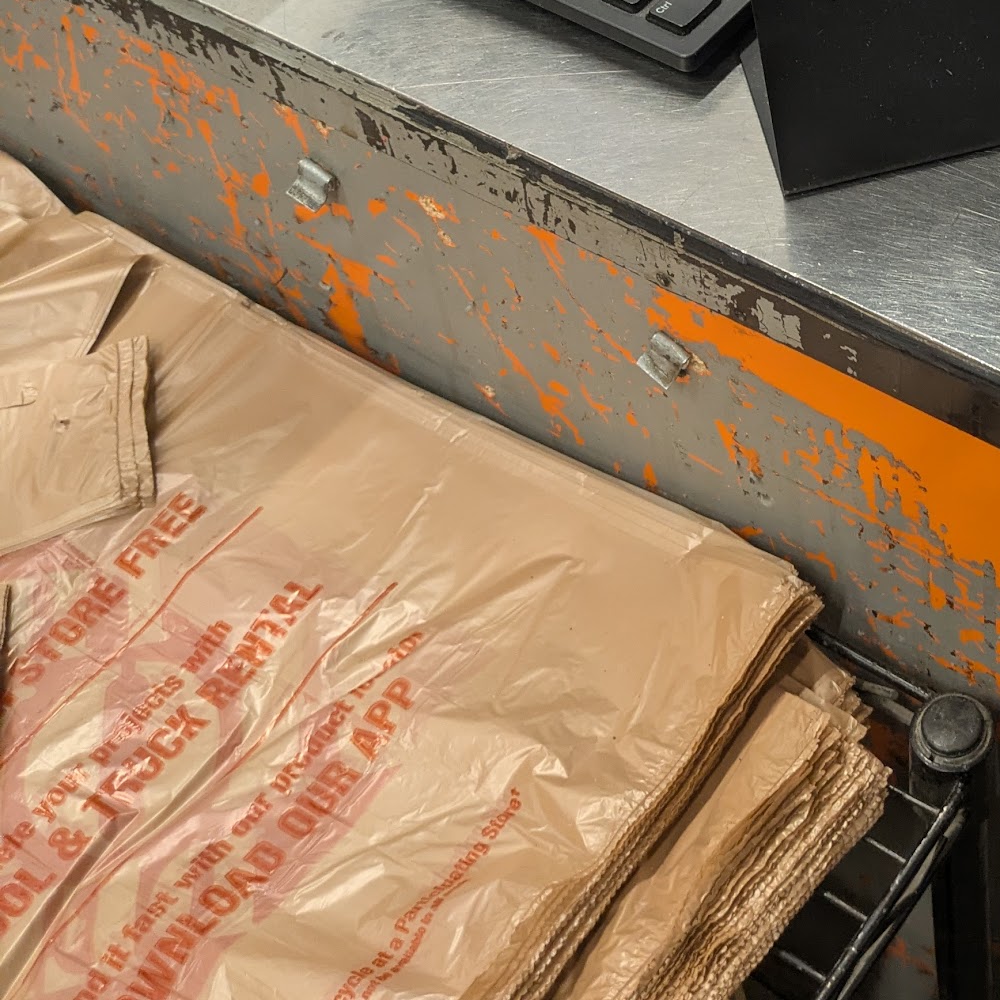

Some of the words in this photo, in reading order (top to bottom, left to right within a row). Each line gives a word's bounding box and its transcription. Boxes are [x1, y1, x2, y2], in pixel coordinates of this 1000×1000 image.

[655, 0, 673, 14] Ctrl
[9, 575, 129, 686] STORE
[113, 490, 208, 580] FREE
[0, 867, 58, 940] OL
[48, 826, 93, 862] &
[79, 703, 213, 821] TRUCK
[195, 580, 325, 710] RENTAL
[31, 763, 92, 824] your
[88, 674, 186, 768] projects
[180, 619, 235, 675] with
[277, 759, 364, 840] OUR
[350, 676, 415, 763] APP
[100, 943, 131, 973] it
[121, 890, 180, 943] fast
[173, 839, 235, 890] with
[232, 791, 273, 838] our
[270, 699, 356, 798] product
[371, 950, 395, 969] at
[389, 936, 405, 951] a
